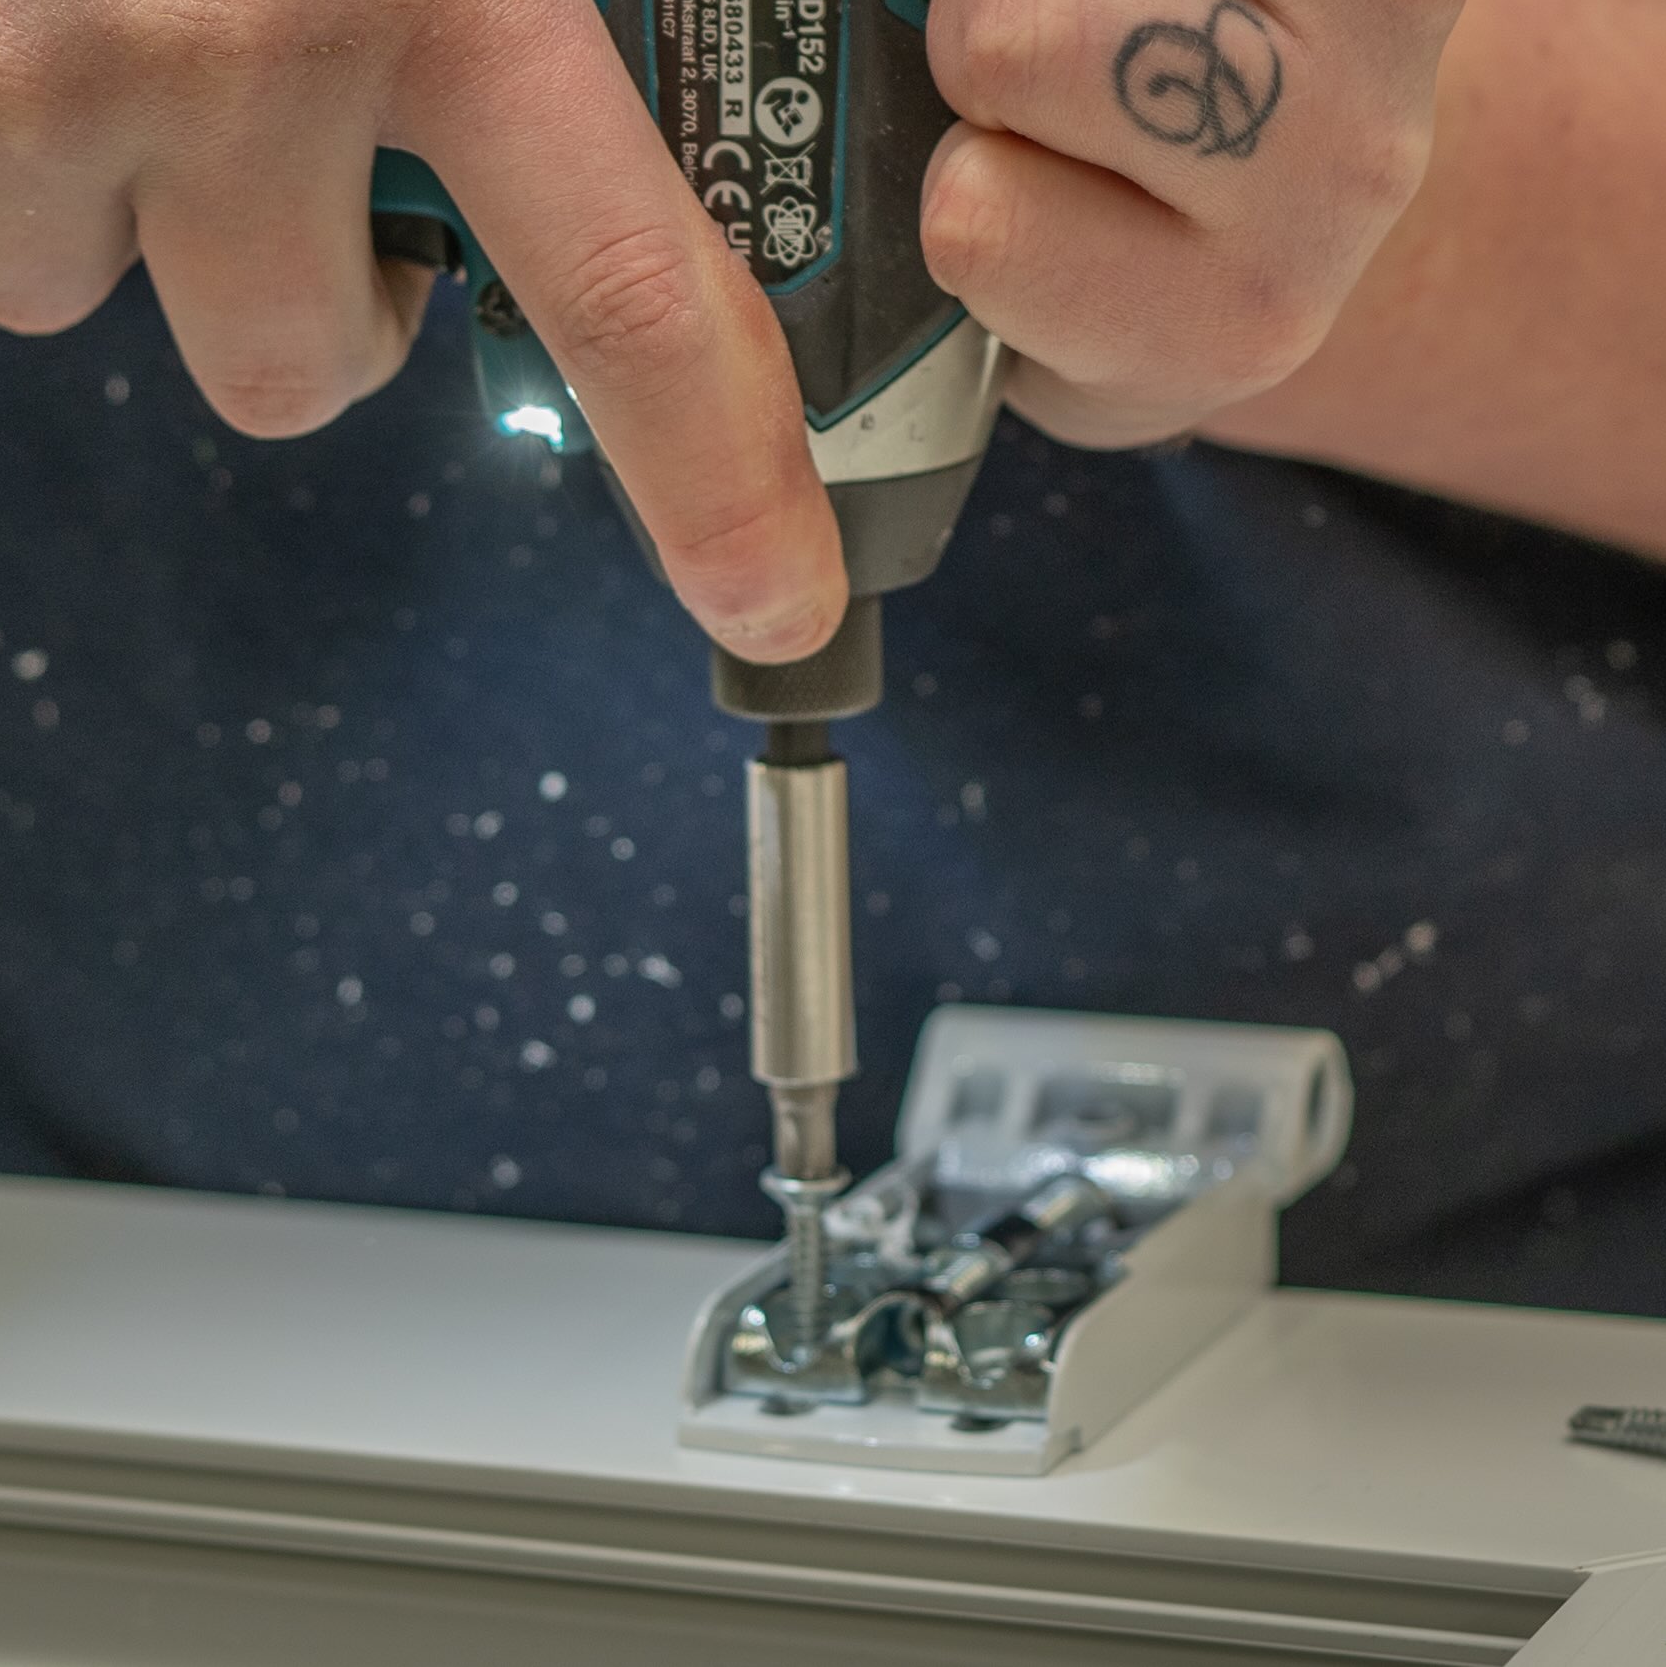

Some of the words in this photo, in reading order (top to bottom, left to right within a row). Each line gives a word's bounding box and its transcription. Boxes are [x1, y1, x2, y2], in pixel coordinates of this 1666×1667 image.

[699, 8, 717, 48] 8JD,
[680, 67, 696, 84] 2,
[701, 55, 718, 81] UK
[680, 88, 697, 137] 3070,
[724, 98, 744, 119] R
